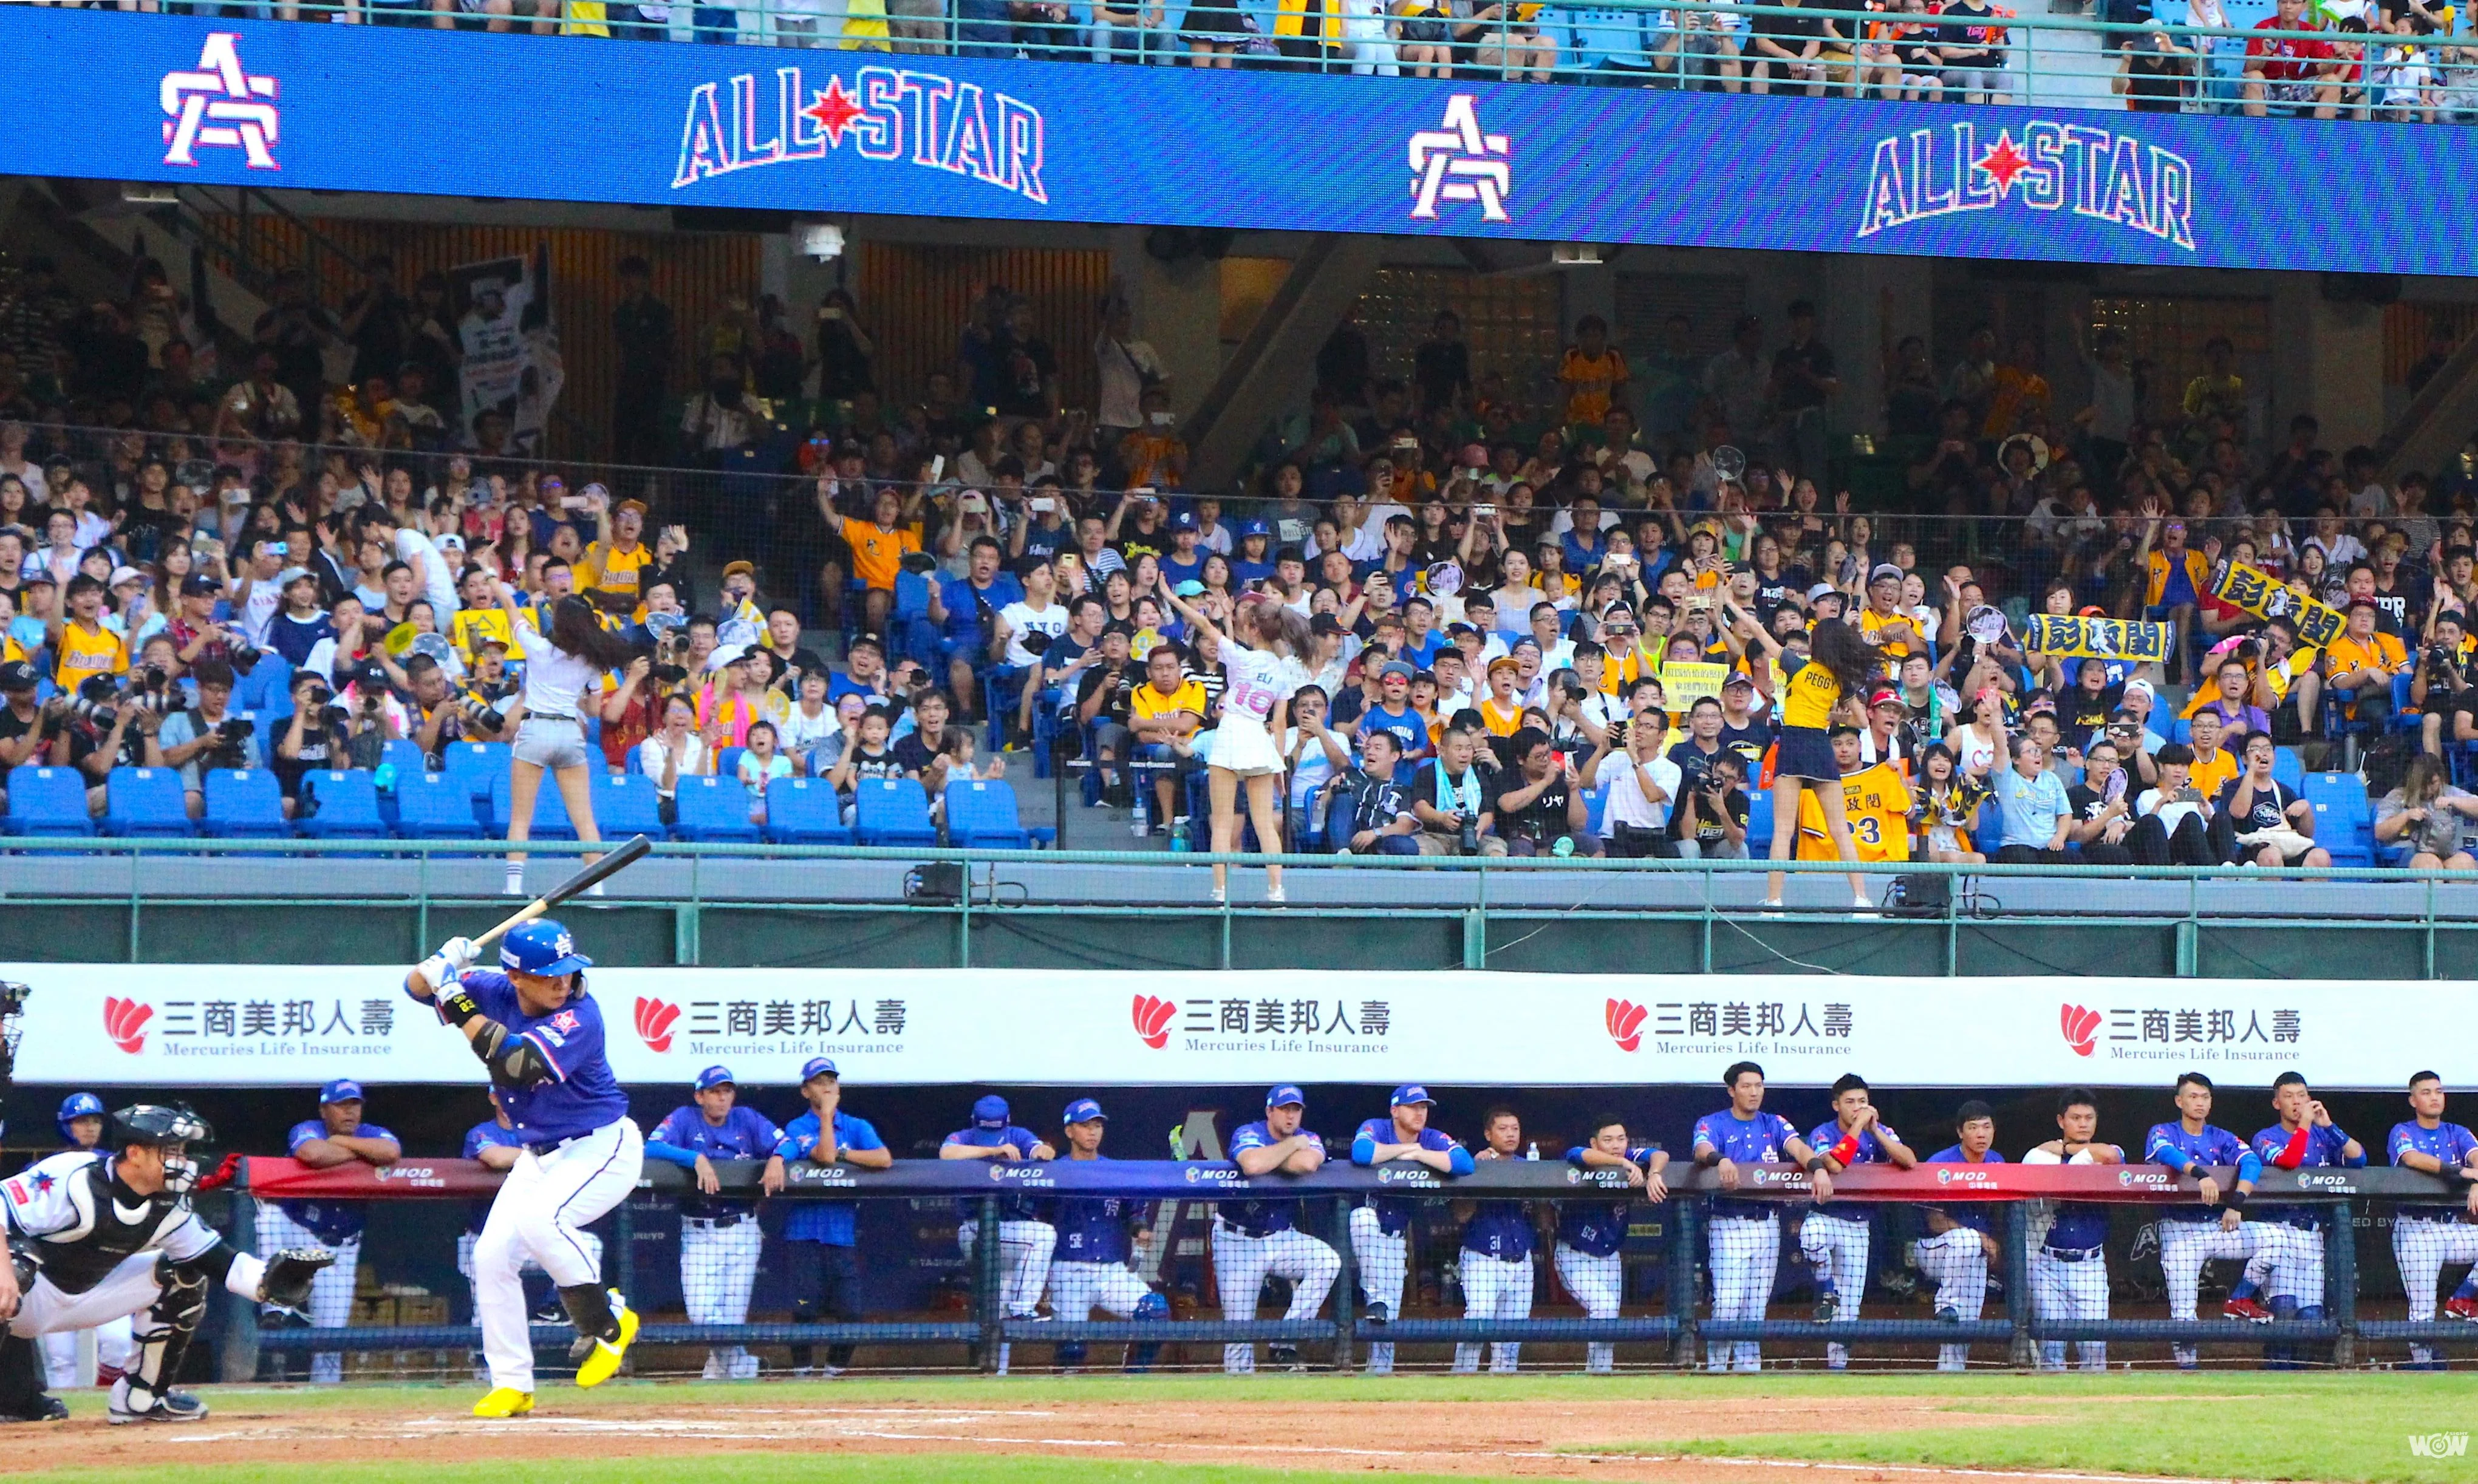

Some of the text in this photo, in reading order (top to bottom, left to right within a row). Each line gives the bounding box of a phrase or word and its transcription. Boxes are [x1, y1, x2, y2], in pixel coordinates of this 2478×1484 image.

[671, 65, 1048, 205] ALL STAR
[1857, 120, 2196, 252] ALL STAR
[1257, 672, 1274, 686] ELI
[1804, 671, 1835, 692] PEGGY
[1235, 681, 1275, 715] 10
[1846, 792, 1881, 811] 政閔
[162, 998, 395, 1037] 三商美邦人壽
[688, 998, 907, 1037] 三商美邦人壽
[1183, 997, 1391, 1036] 三商美邦人壽
[1654, 1000, 1853, 1038] 三商美邦人壽
[2108, 1007, 2301, 1044] 三商美邦人壽
[165, 1042, 392, 1056] Mercuries Life Insurance
[690, 1040, 904, 1055] Mercuries Life Insurance
[1184, 1038, 1389, 1053] Mercuries Life Insurance
[1656, 1041, 1852, 1055] Mercuries Life Insurance
[2111, 1046, 2300, 1061] Mercuries Life Insurance
[392, 1168, 434, 1178] MOD
[805, 1168, 845, 1178] MOD
[1005, 1168, 1044, 1178] MOD
[1201, 1169, 1238, 1180] MOD
[1393, 1170, 1430, 1180] MOD
[1582, 1171, 1618, 1181] MOD
[1768, 1172, 1803, 1182] MOD
[1951, 1172, 1987, 1181] MOD
[2133, 1174, 2168, 1183] MOD
[2312, 1176, 2346, 1185] MOD
